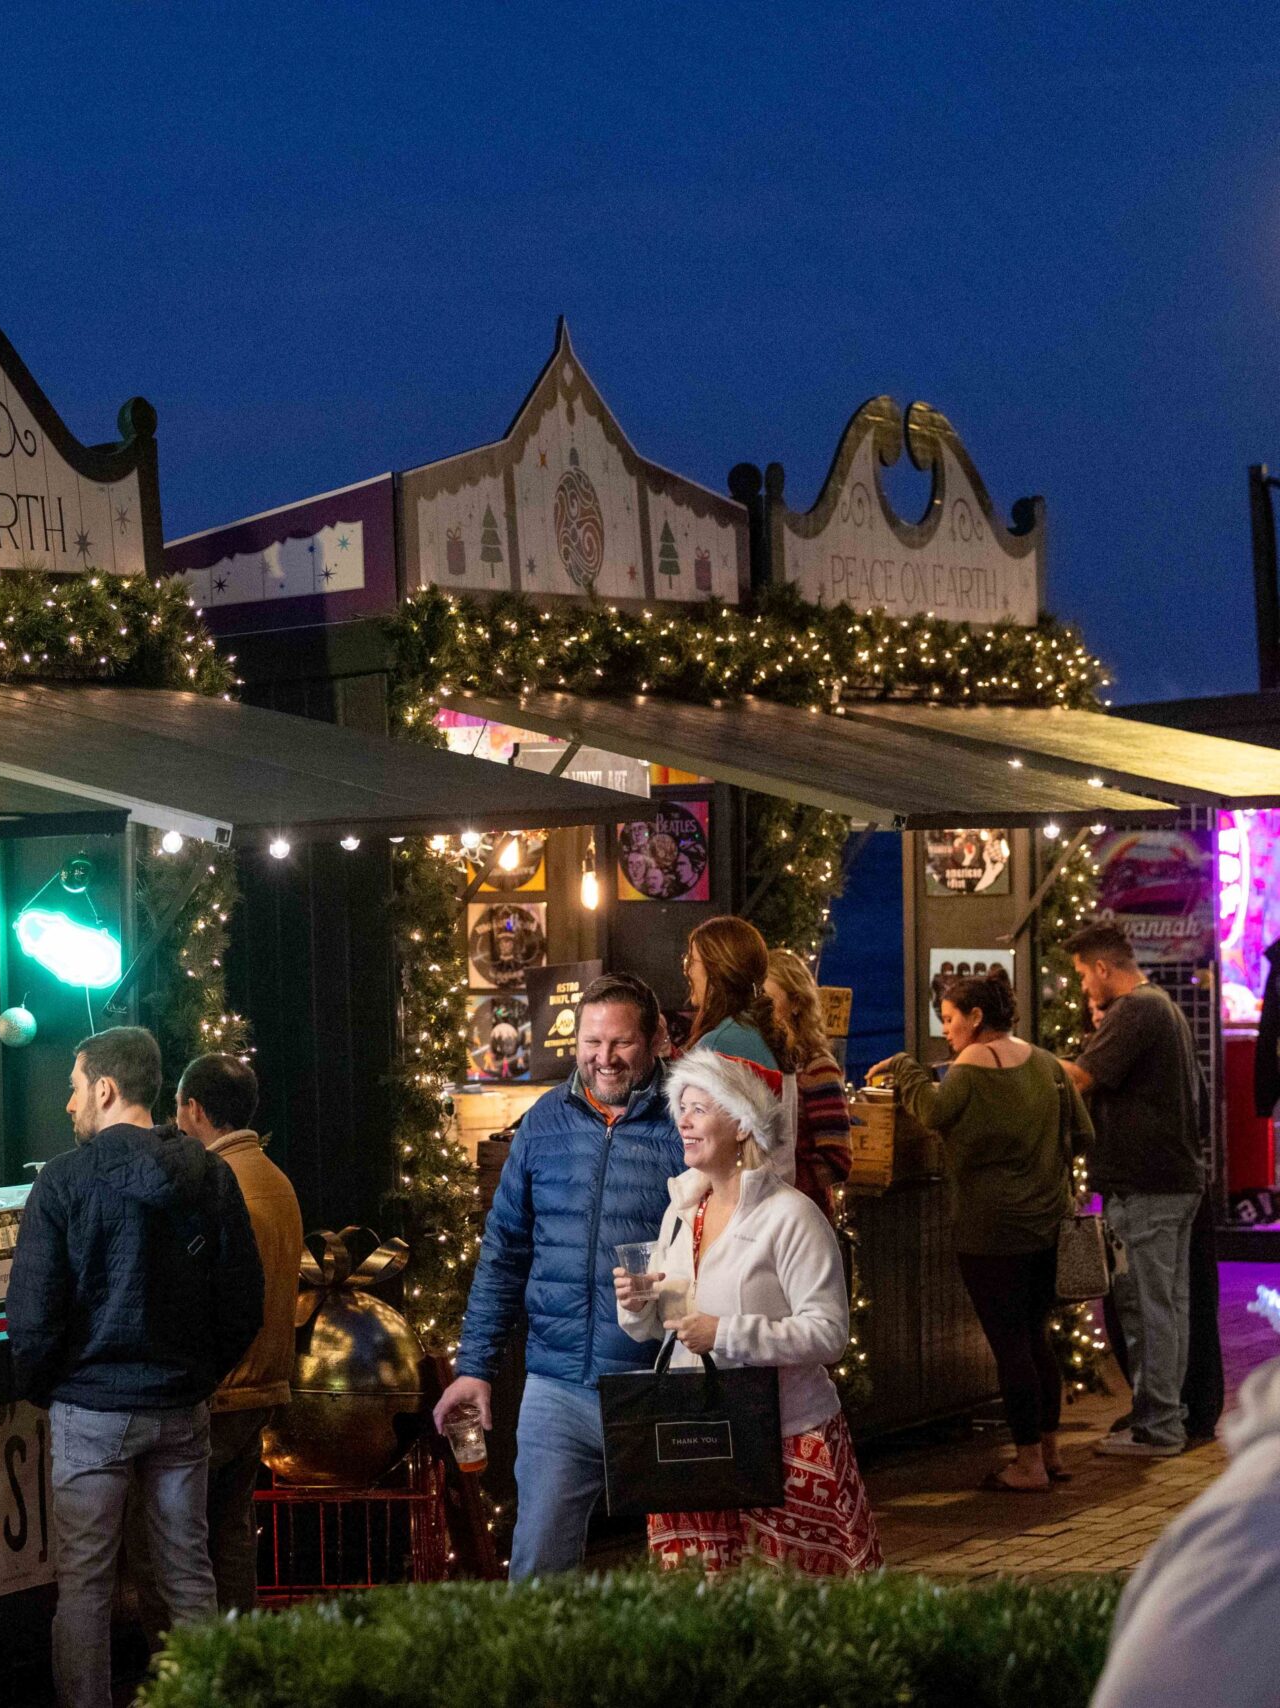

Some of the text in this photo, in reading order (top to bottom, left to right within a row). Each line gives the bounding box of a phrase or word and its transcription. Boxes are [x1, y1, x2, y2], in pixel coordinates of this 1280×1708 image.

[831, 554, 998, 610] PEACE ON EARTH
[1102, 908, 1201, 938] vannah
[671, 1436, 718, 1446] THANK YOU
